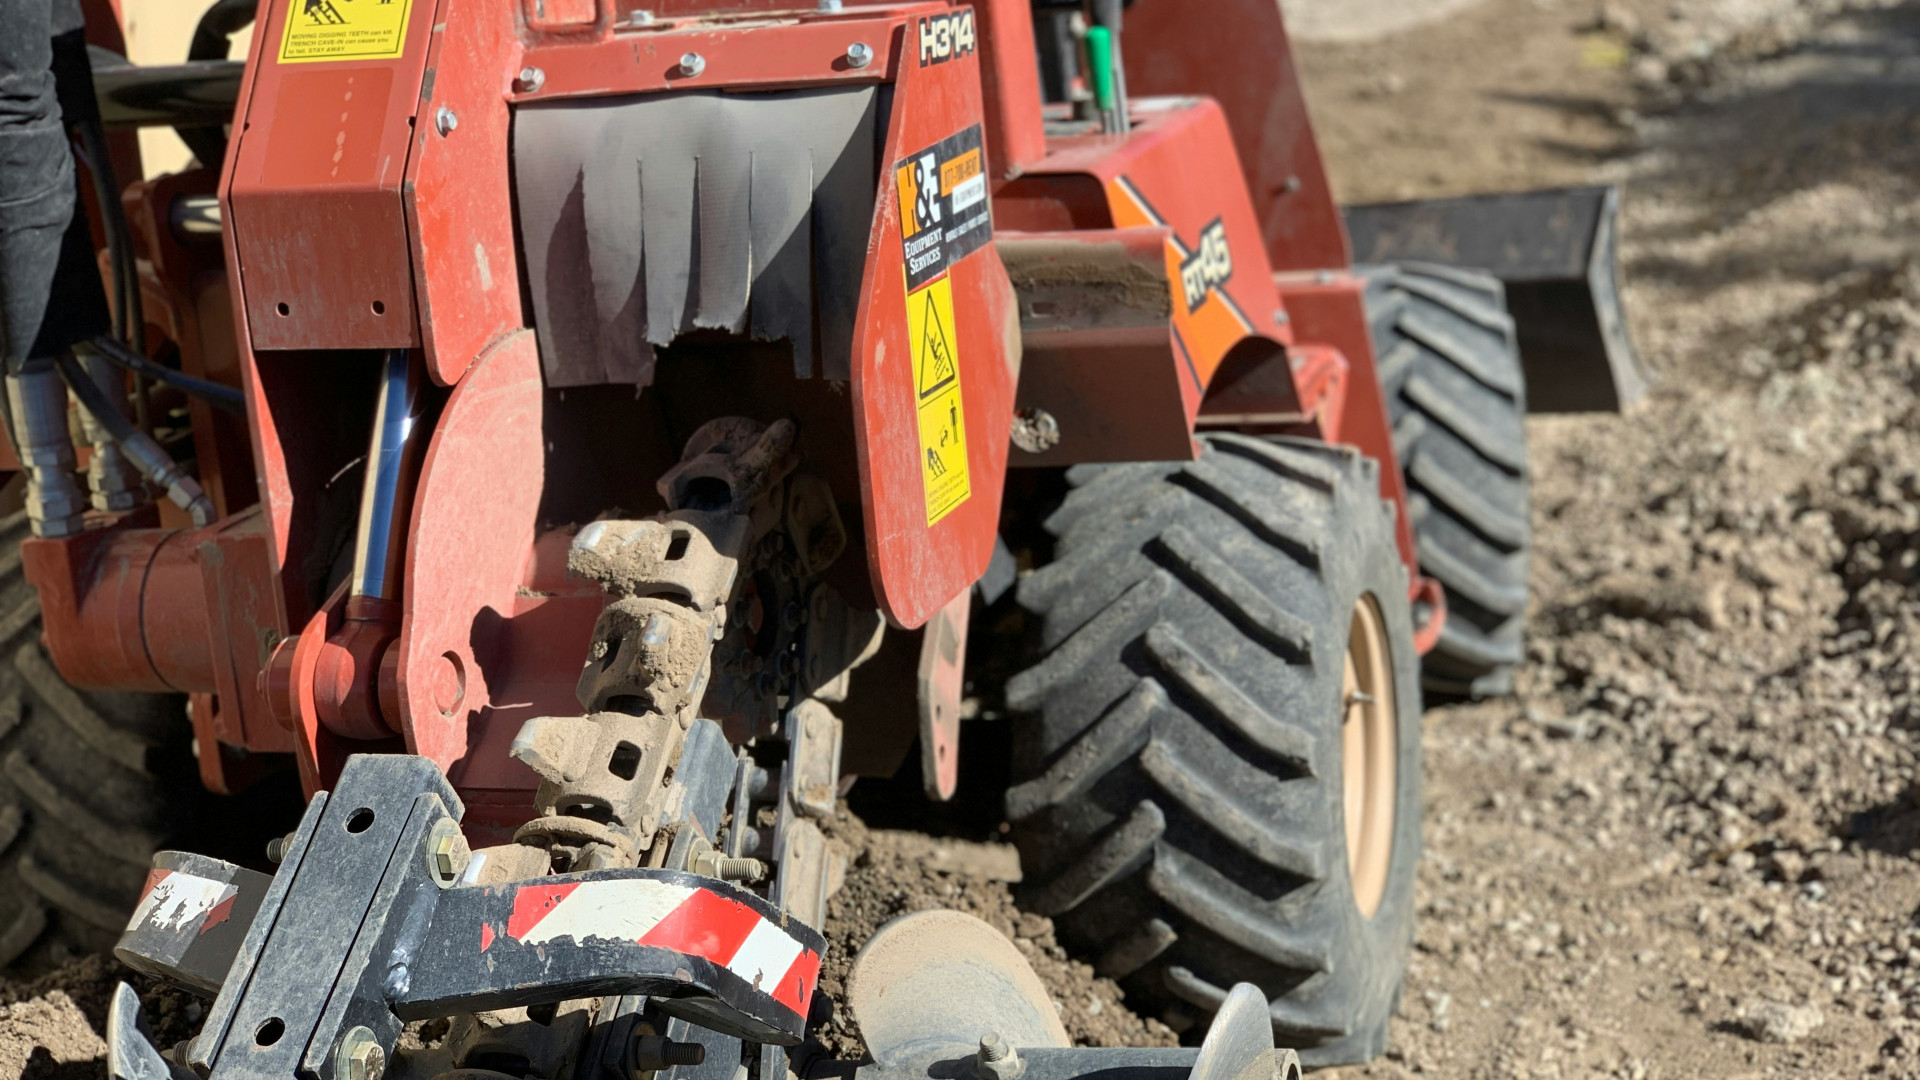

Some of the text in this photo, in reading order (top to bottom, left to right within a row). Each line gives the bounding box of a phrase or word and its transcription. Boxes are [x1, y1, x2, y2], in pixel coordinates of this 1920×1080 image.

[318, 31, 346, 39] DIGGING
[318, 38, 343, 46] CAVE-IN
[919, 11, 974, 63] H314
[896, 152, 942, 239] H&E
[1182, 221, 1231, 307] RT45
